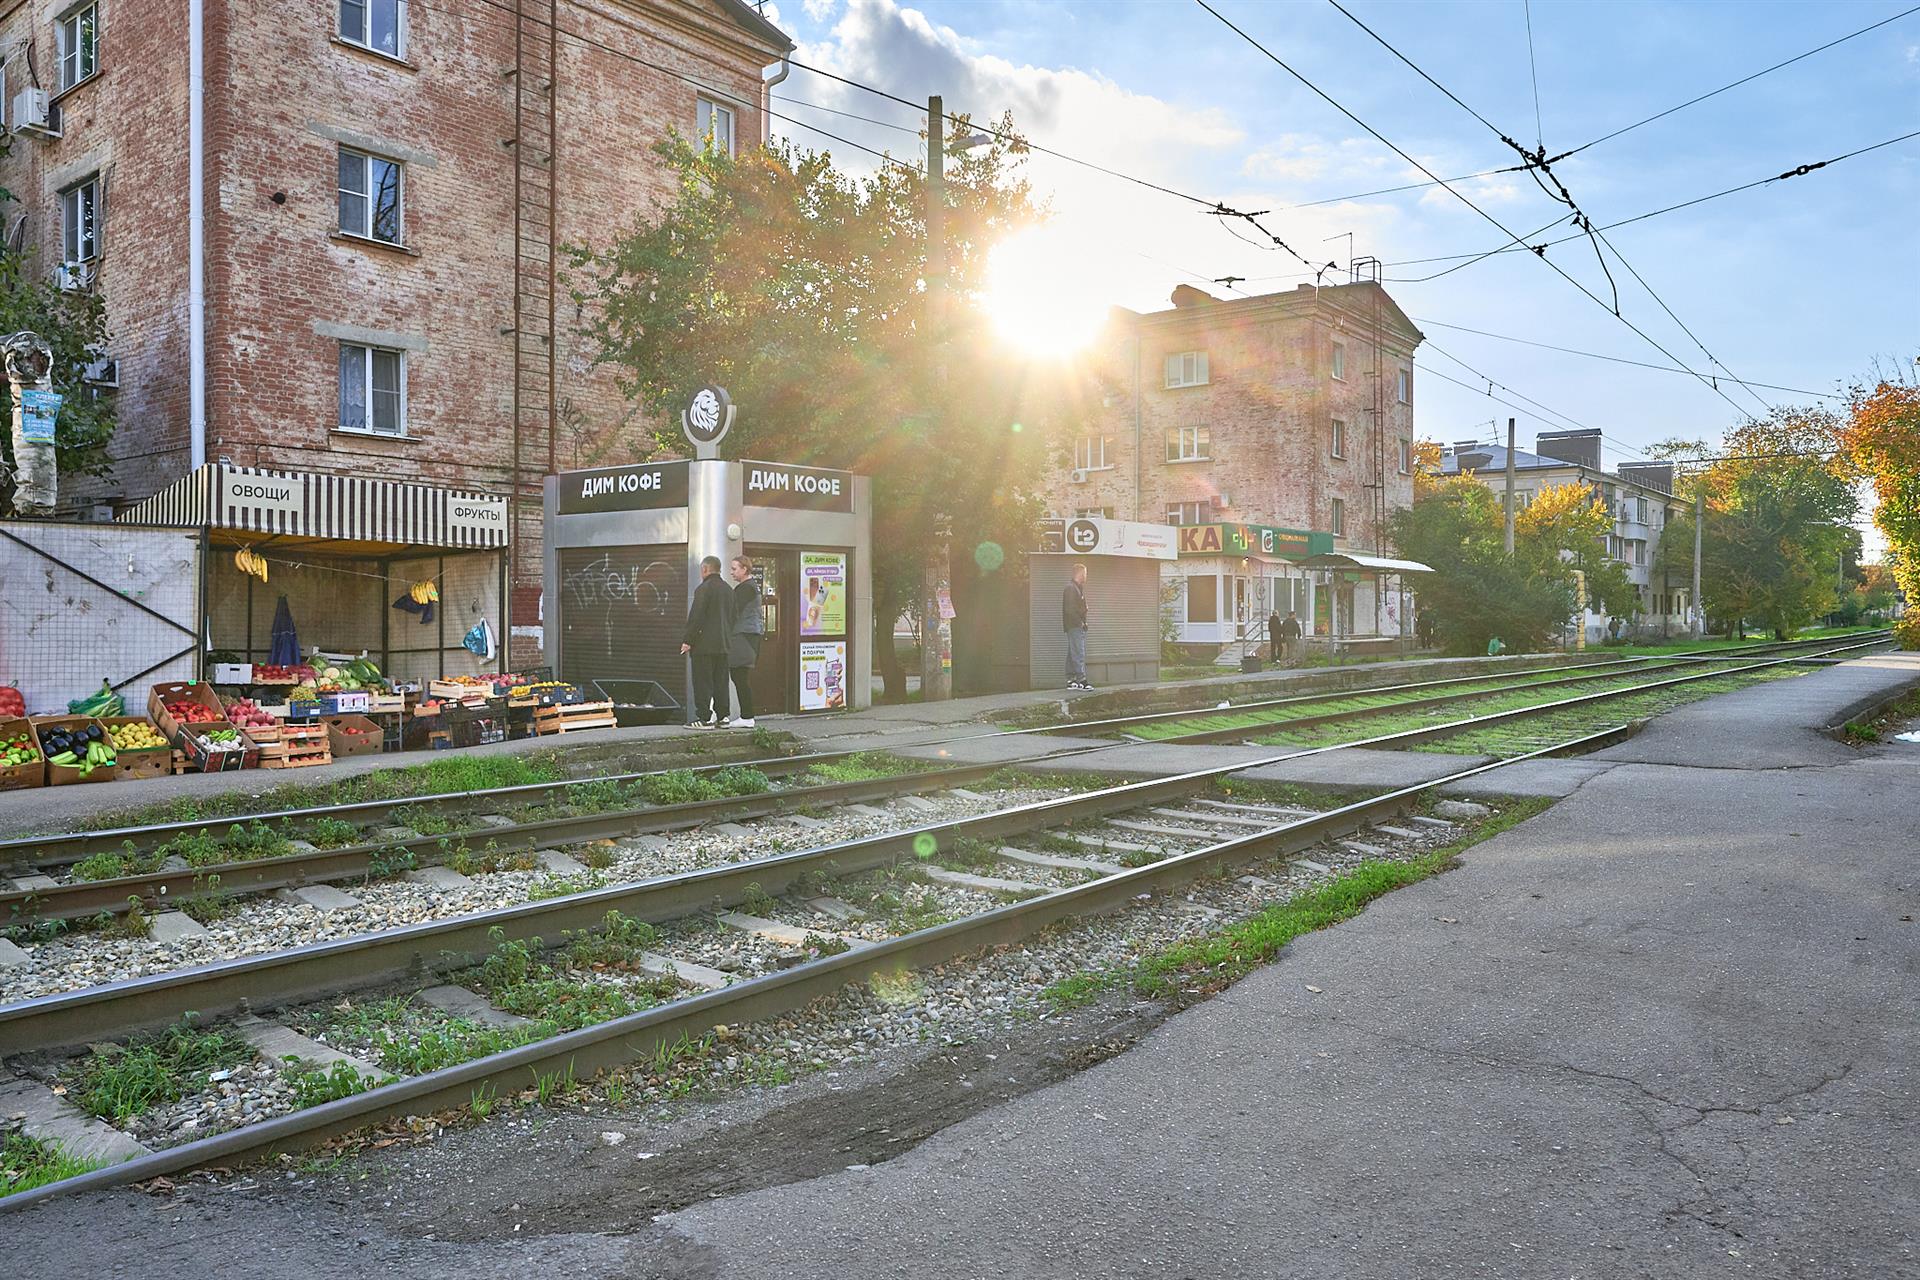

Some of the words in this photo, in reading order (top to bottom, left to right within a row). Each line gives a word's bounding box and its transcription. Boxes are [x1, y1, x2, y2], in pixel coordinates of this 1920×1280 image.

[232, 484, 290, 502] ОВОЩИ
[582, 476, 614, 498] ДИМ
[618, 472, 661, 493] КОФЕ
[748, 470, 789, 491] ДИМ
[794, 475, 840, 496] КОФЕ
[454, 507, 500, 521] ФРУКТЫ
[1181, 527, 1221, 551] КА
